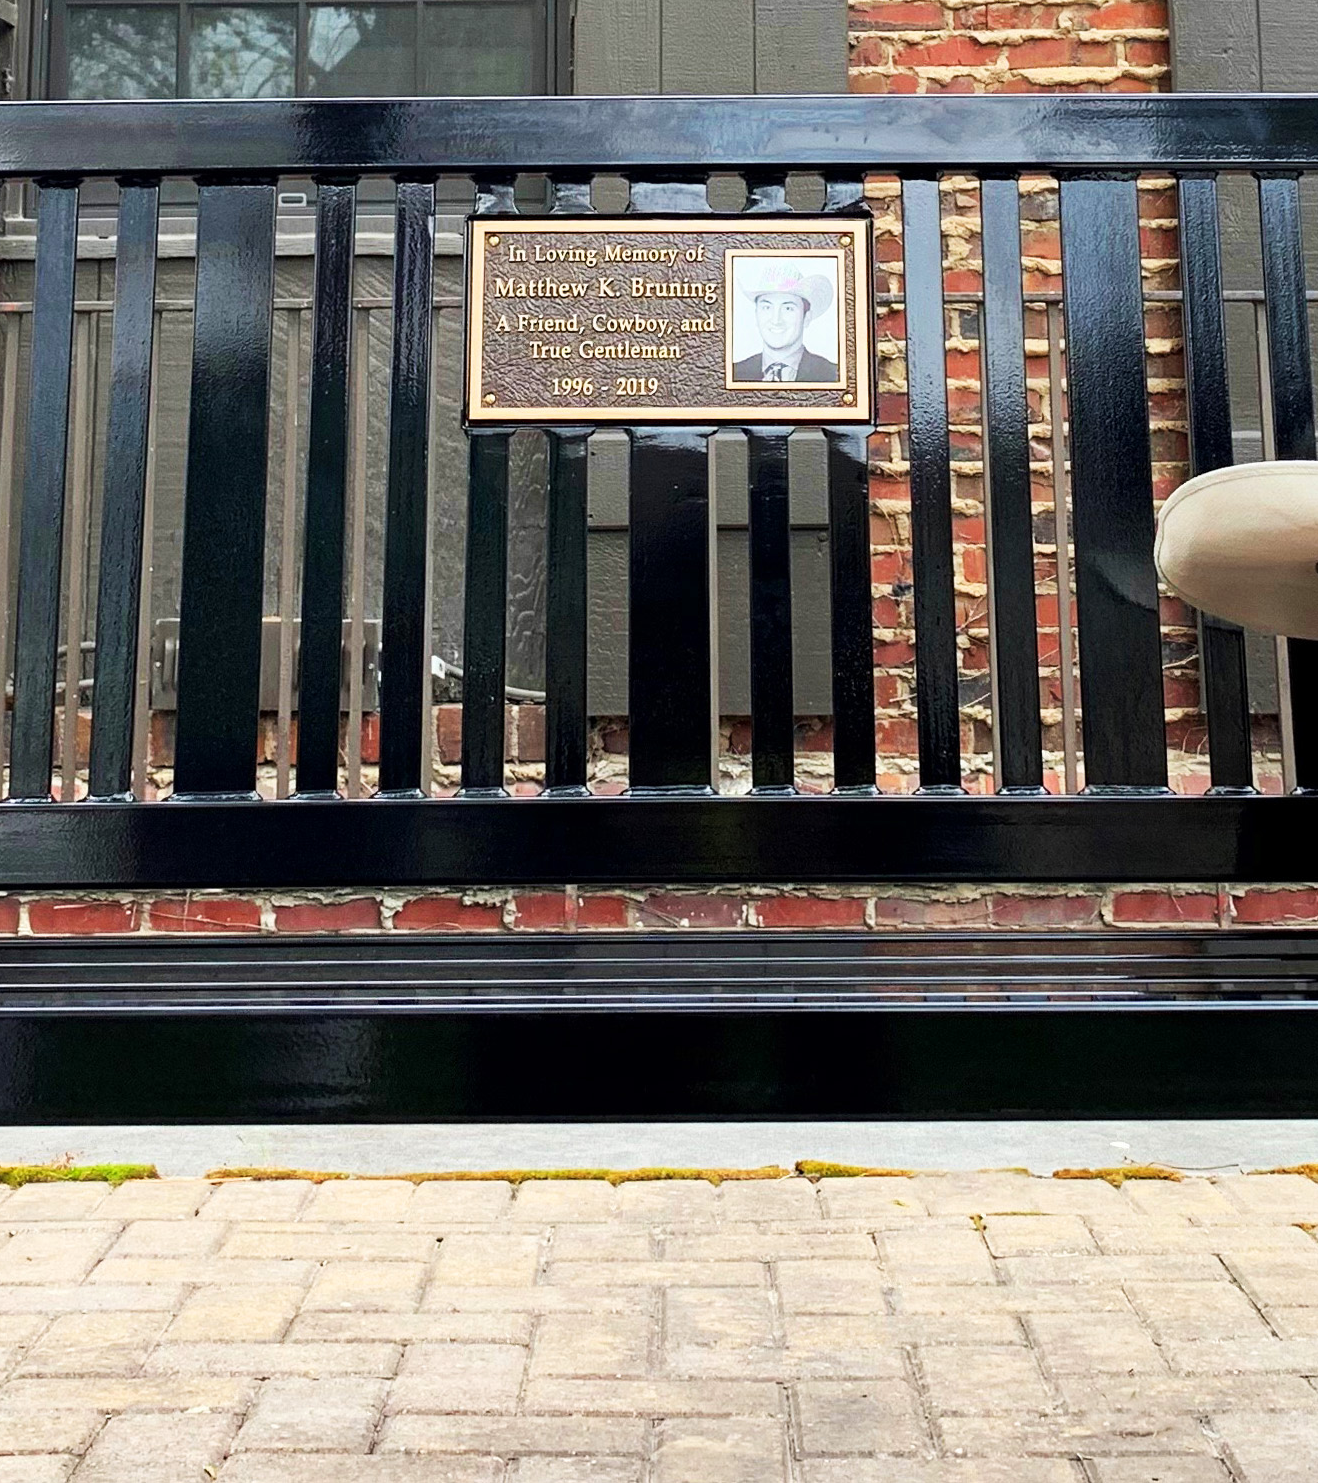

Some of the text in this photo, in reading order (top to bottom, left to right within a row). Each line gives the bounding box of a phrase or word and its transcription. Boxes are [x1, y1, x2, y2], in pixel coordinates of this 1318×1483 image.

[508, 245, 704, 266] In Loving Memory of
[495, 278, 717, 302] Matthew K. Bruning
[495, 315, 715, 337] A Friend, Cowboy, and
[530, 341, 681, 359] True Gentleman
[552, 378, 593, 396] 1996
[616, 378, 658, 396] 2019
